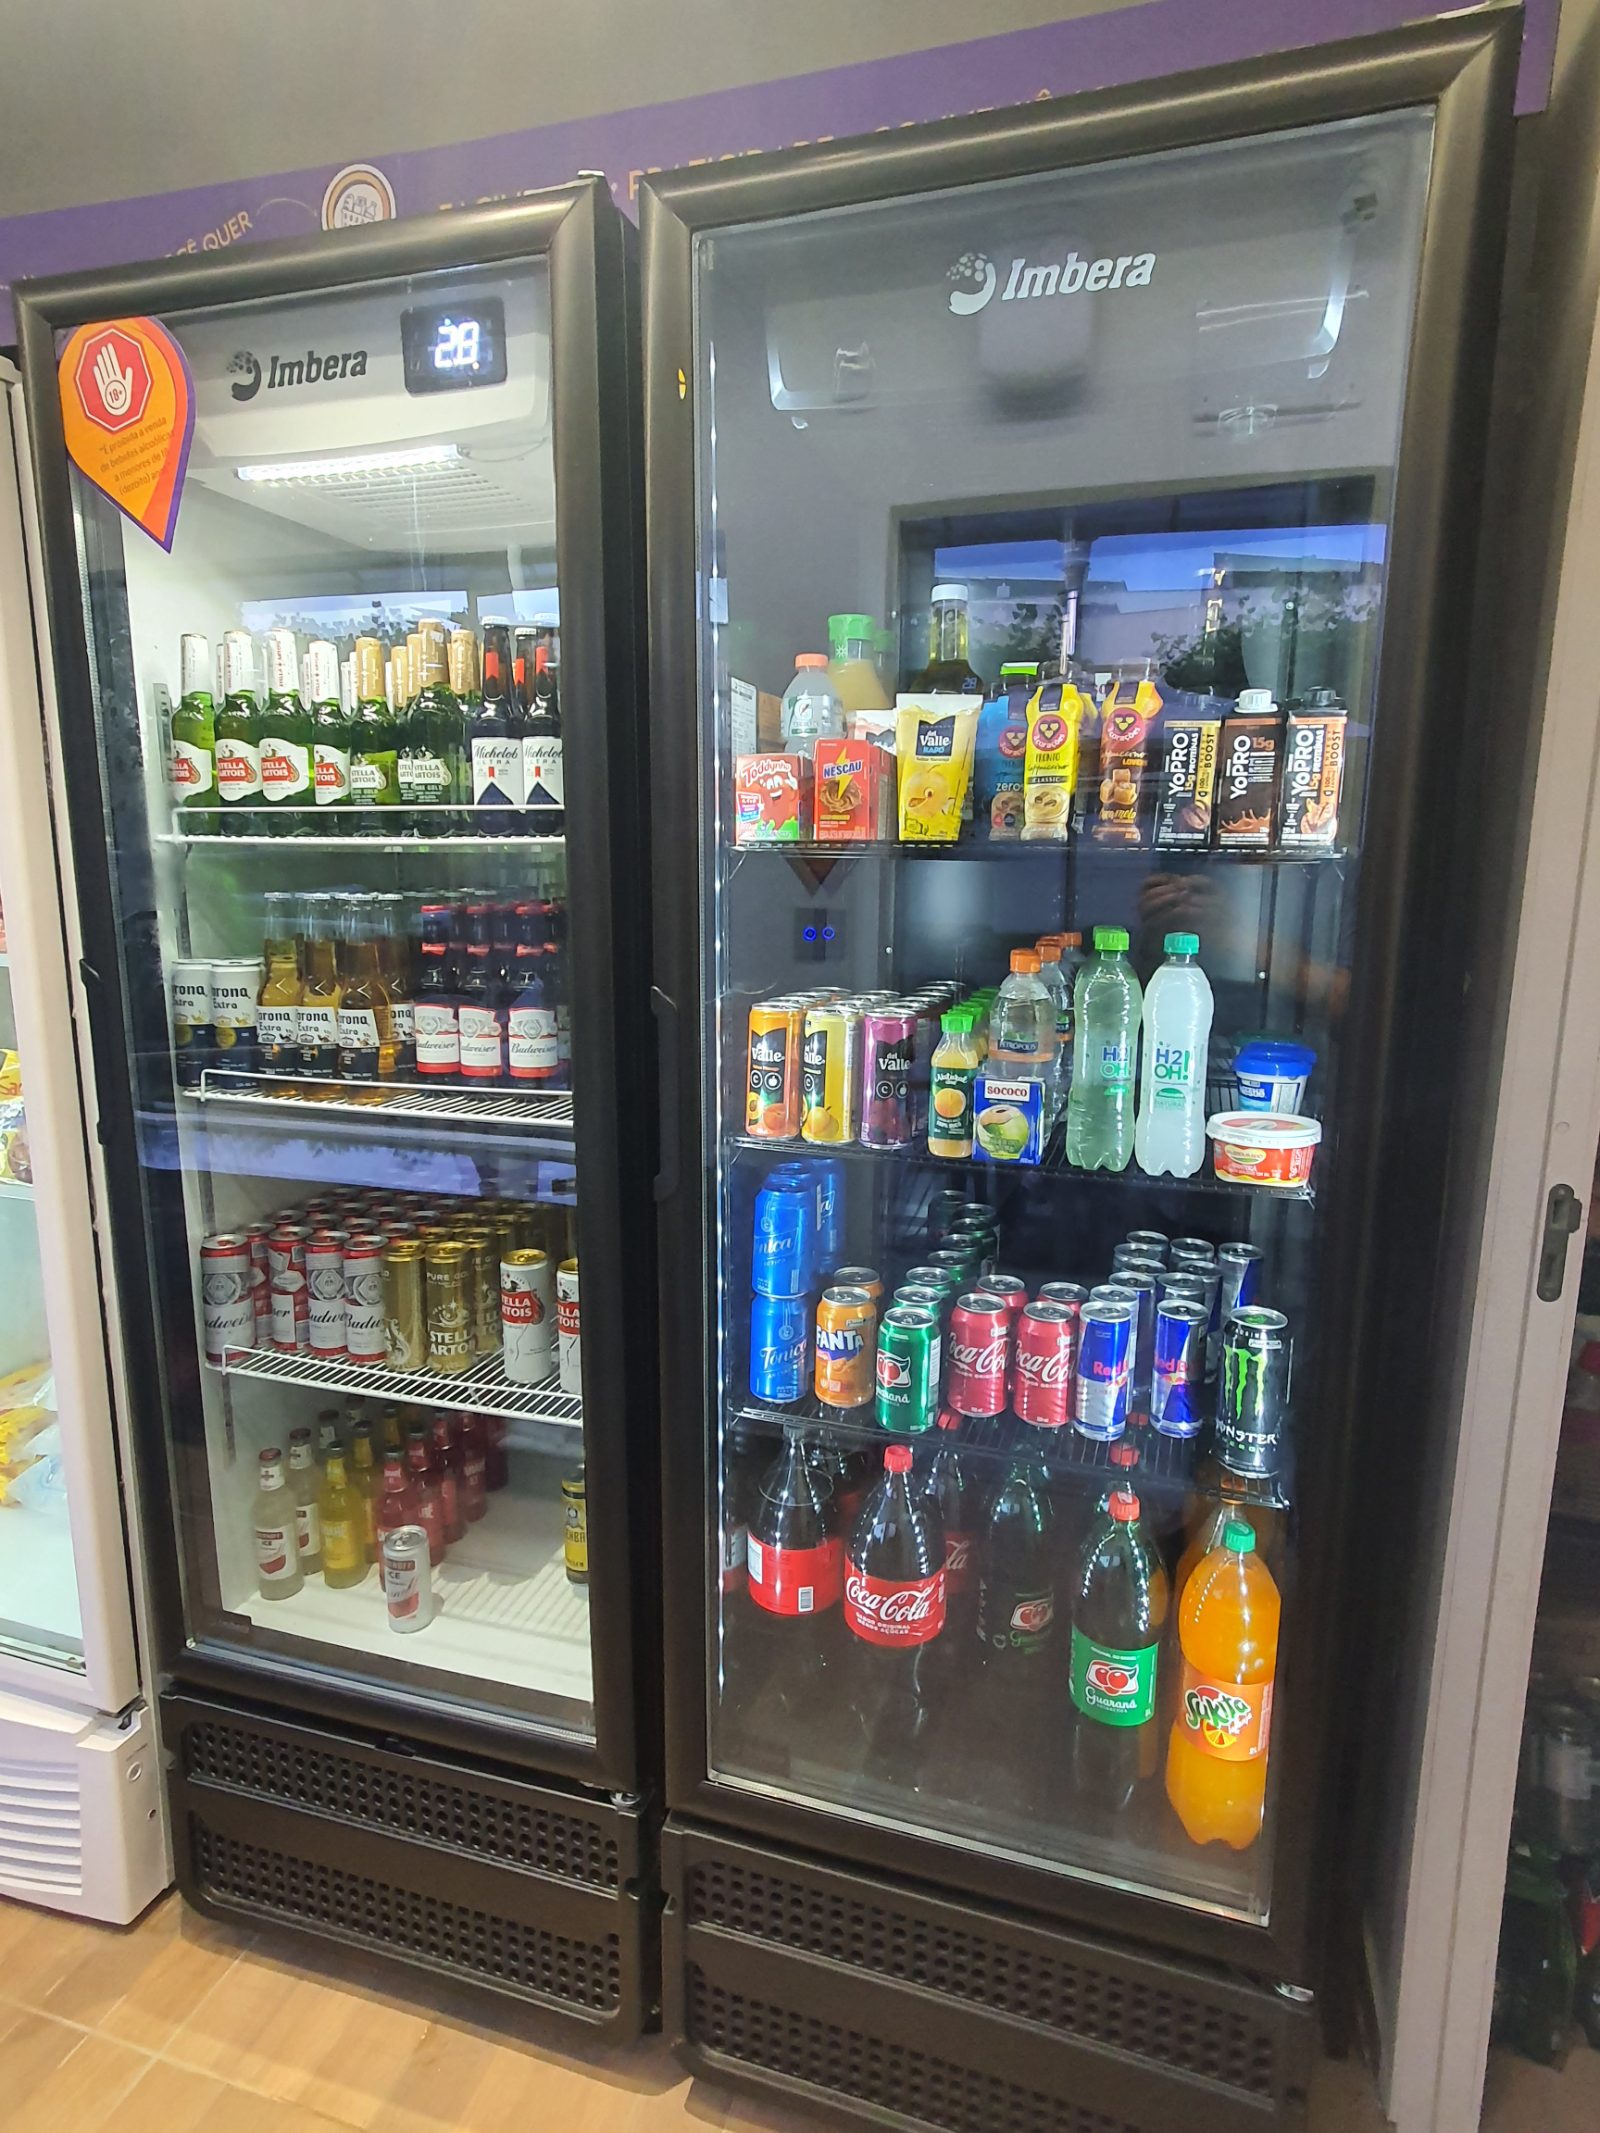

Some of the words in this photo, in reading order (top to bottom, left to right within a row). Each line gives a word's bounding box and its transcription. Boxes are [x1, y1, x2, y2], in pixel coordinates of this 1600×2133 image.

[203, 211, 253, 252] QUER
[1001, 252, 1156, 301] Imbera
[267, 350, 368, 388] Imbera
[474, 745, 519, 760] Michelob
[919, 734, 951, 746] Valle
[1204, 732, 1215, 769] BOOST
[1252, 736, 1275, 752] 15g
[1330, 730, 1342, 767] BOOST
[741, 759, 791, 787] Toddynho
[823, 760, 862, 778] NESCAU
[1168, 732, 1189, 796] YoPRO
[1230, 735, 1251, 800] YoPRO
[1291, 729, 1315, 796] YoPRO
[1032, 776, 1060, 784] CLASSIC
[1184, 774, 1196, 791] 15g
[1310, 773, 1322, 790] 15g
[878, 1058, 911, 1071] Valle
[1155, 1047, 1183, 1065] H2
[986, 1086, 1028, 1097] SOCOCO
[846, 1576, 935, 1622] Coca-Cola
[1086, 1686, 1137, 1709] Guaraná
[1185, 1689, 1251, 1730] Sukita
